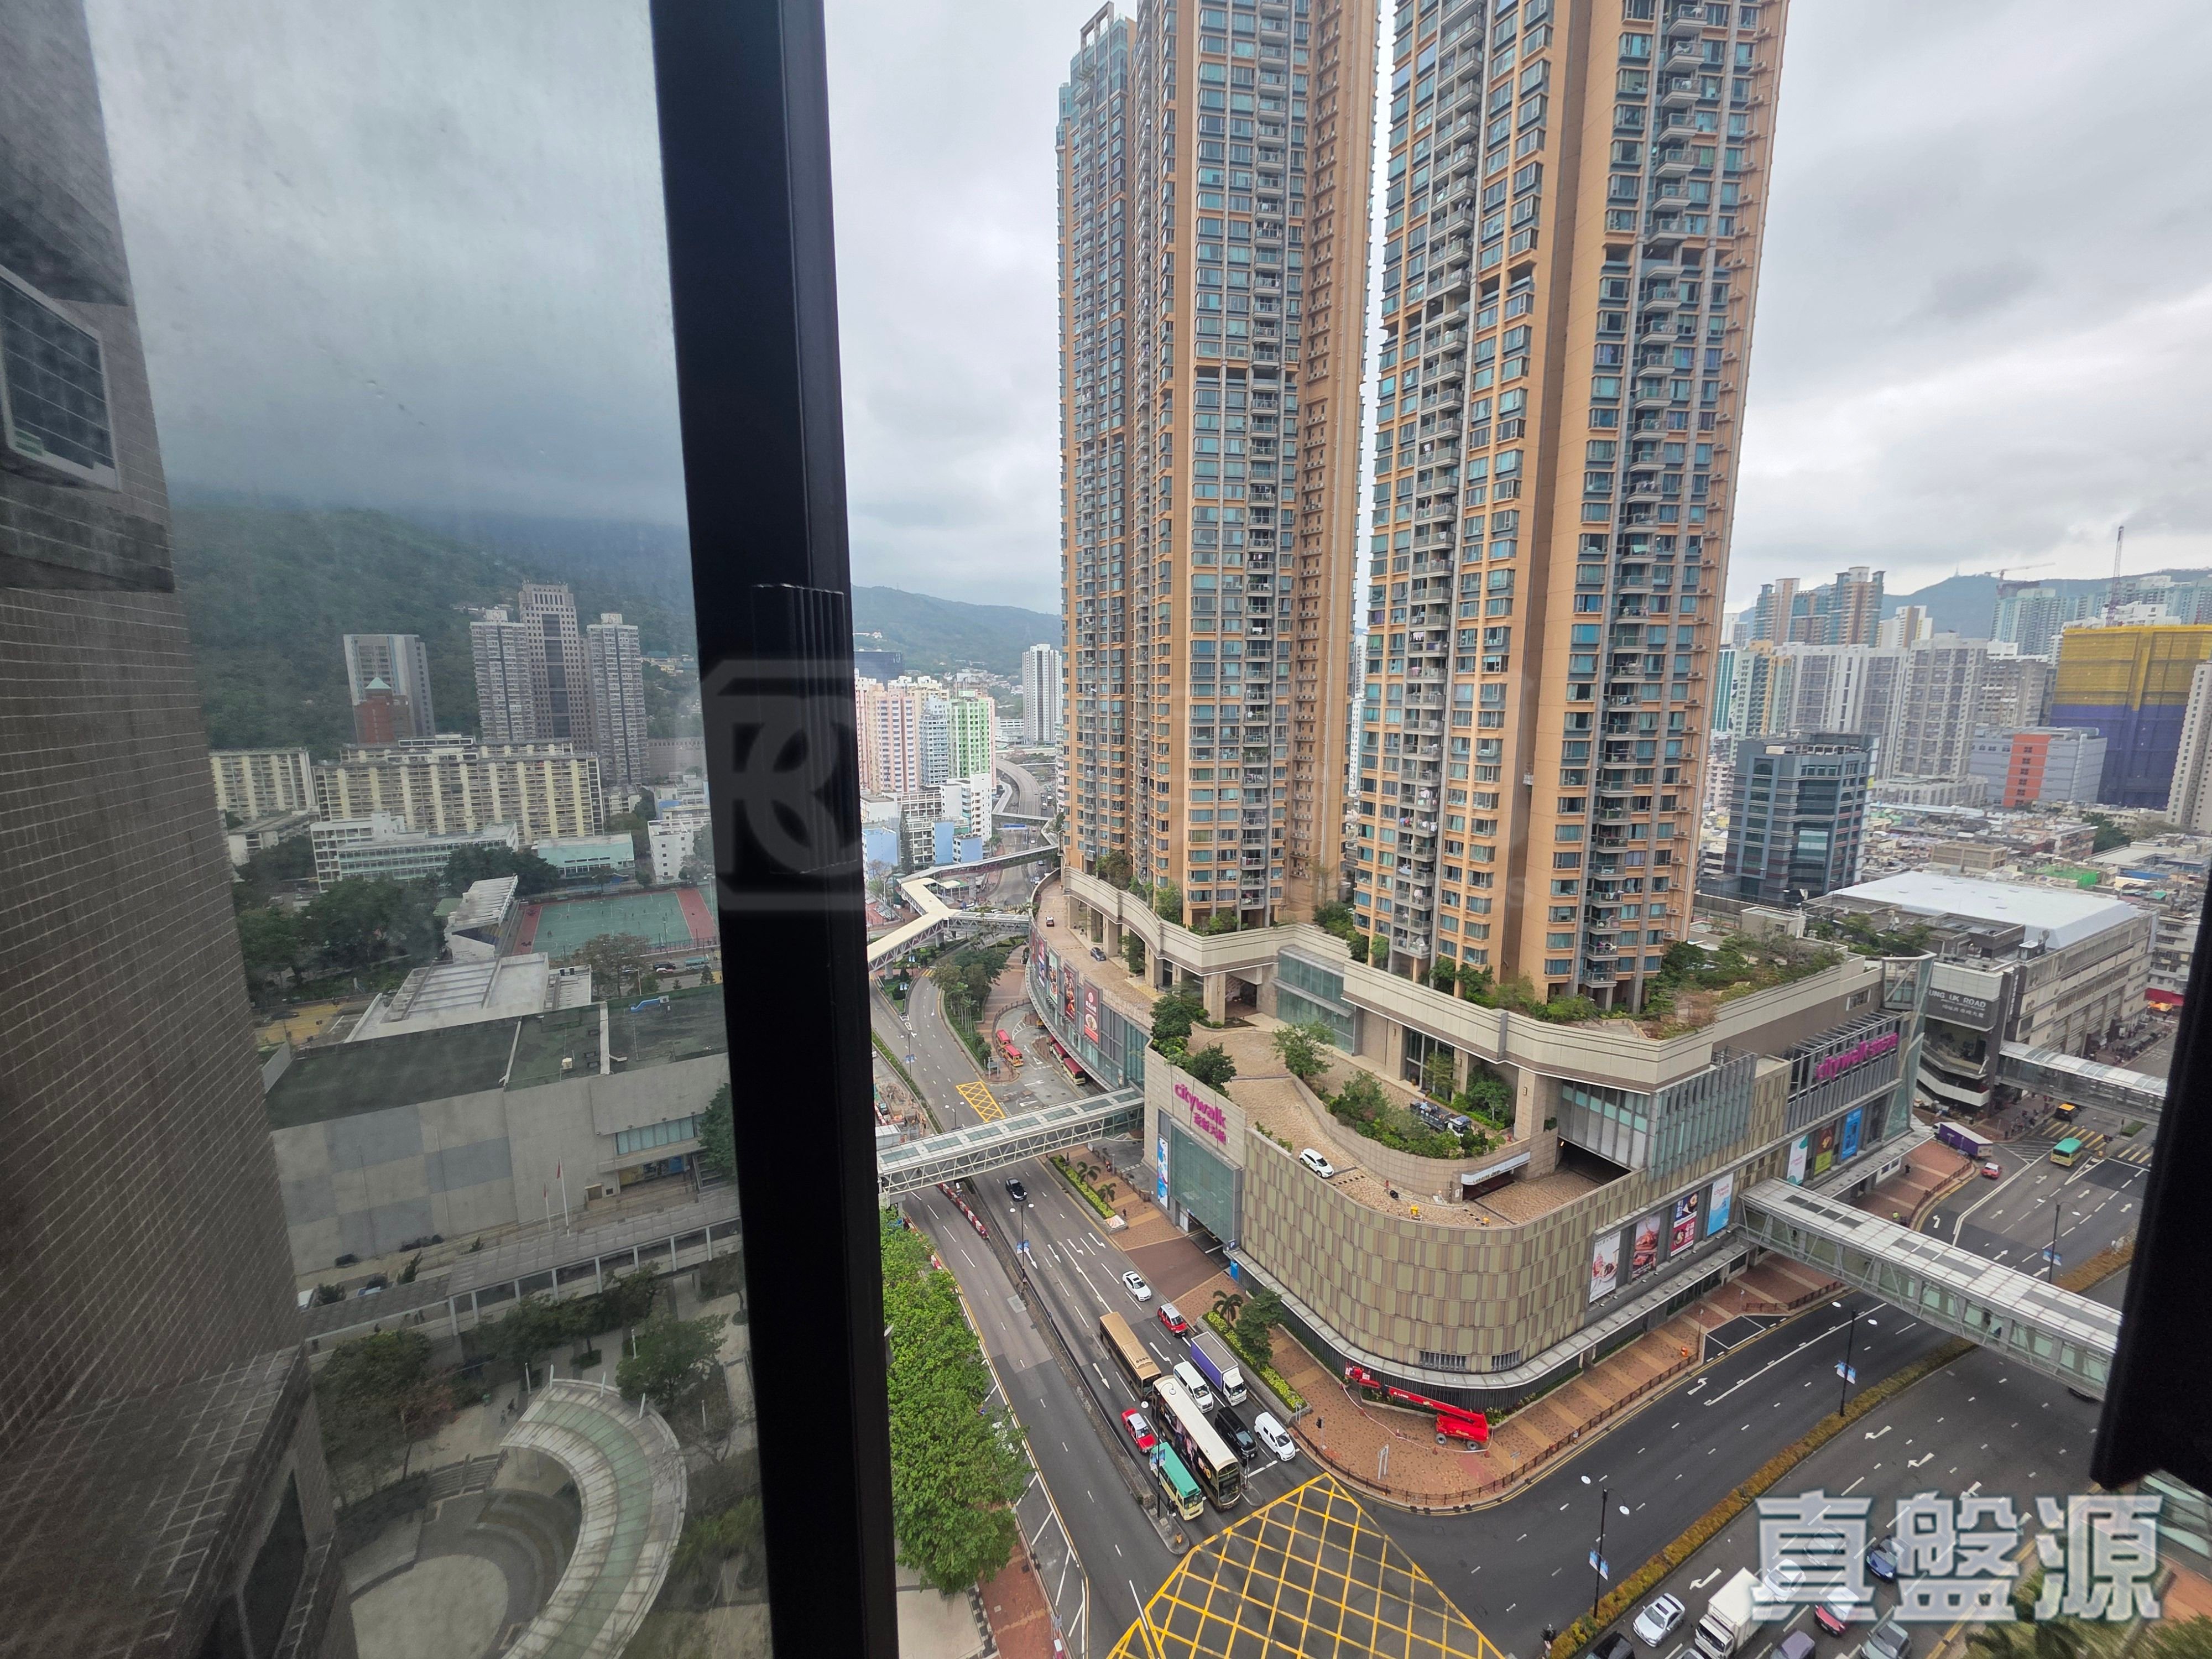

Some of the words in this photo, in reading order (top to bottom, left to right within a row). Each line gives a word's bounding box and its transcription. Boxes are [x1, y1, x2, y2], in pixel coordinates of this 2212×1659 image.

[1928, 989, 1945, 999] UNG
[1949, 994, 1960, 1002] UK
[1963, 997, 1986, 1008] ROAD
[1174, 1084, 1227, 1129] citywalk
